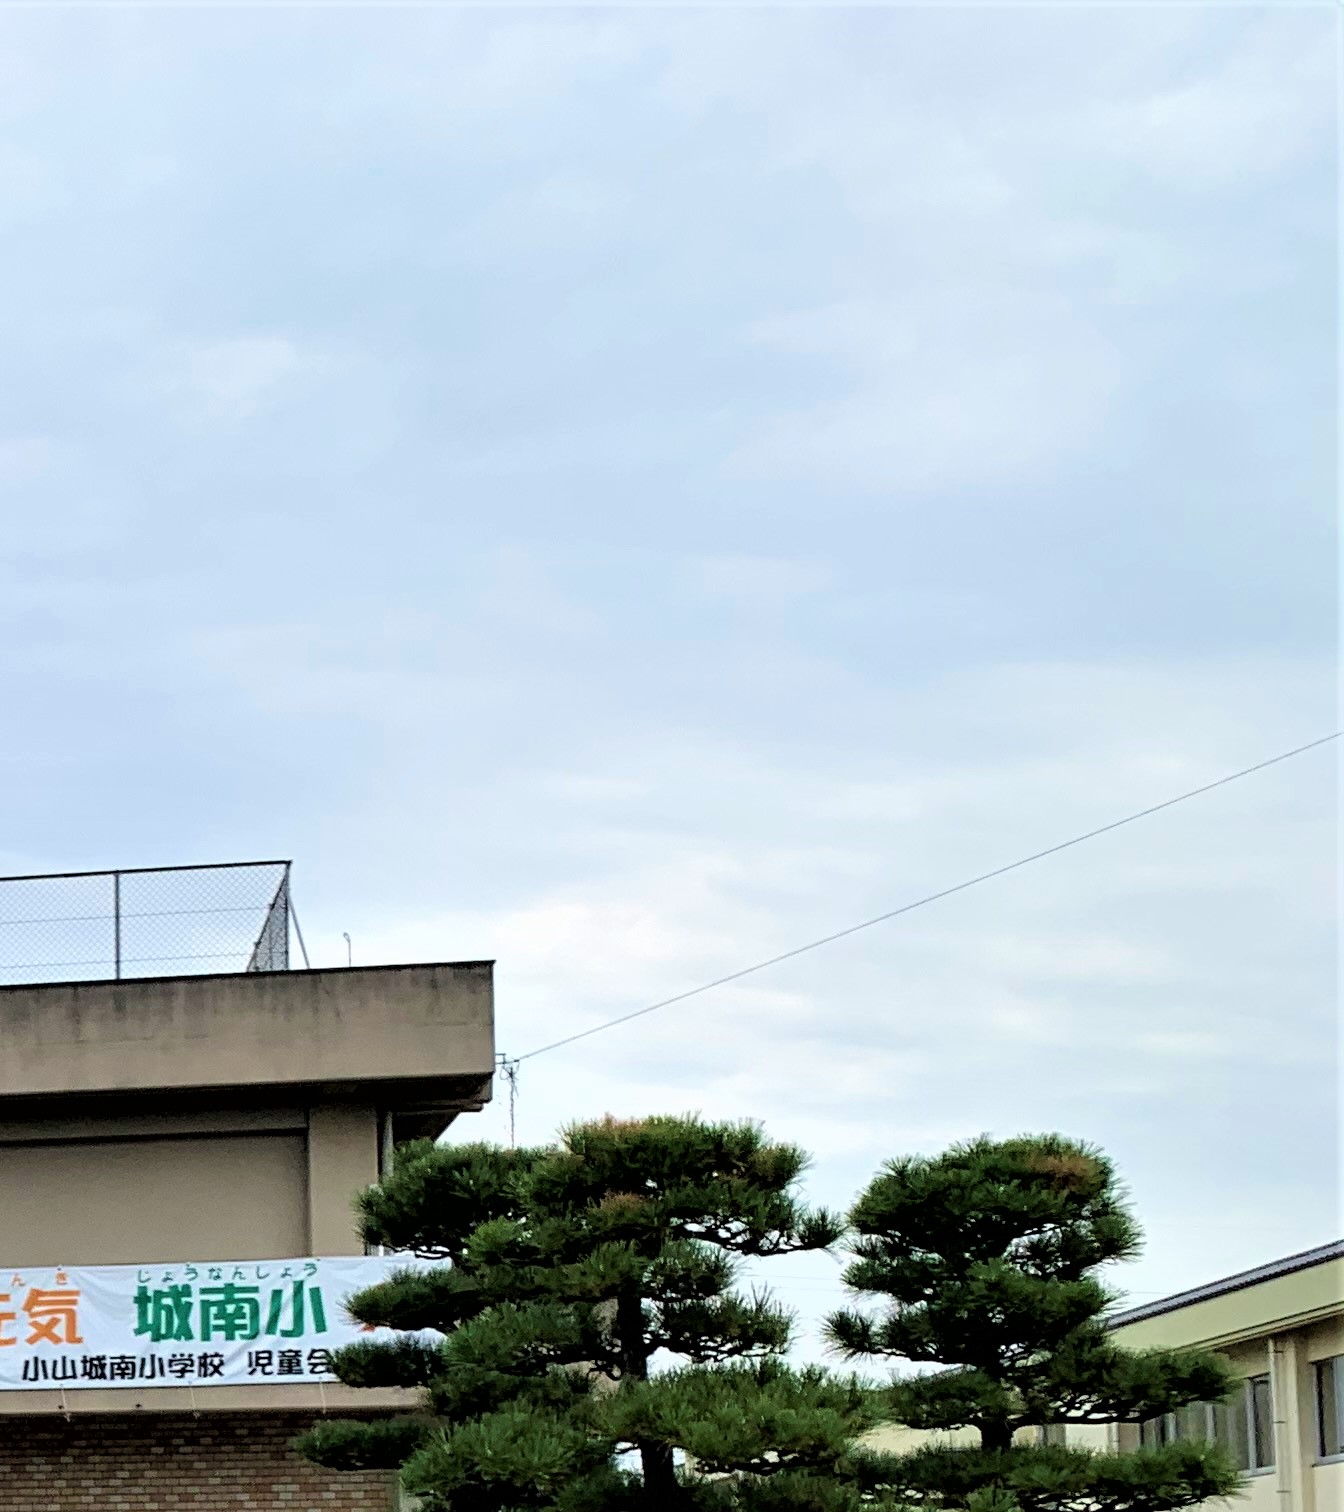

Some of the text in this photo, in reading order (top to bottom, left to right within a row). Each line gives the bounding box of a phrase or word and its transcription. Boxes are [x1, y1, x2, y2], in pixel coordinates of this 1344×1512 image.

[138, 1263, 318, 1283] じょうなんしょう
[133, 1280, 327, 1342] 城南小
[22, 1348, 334, 1382] 小山城南小学校 児童会
